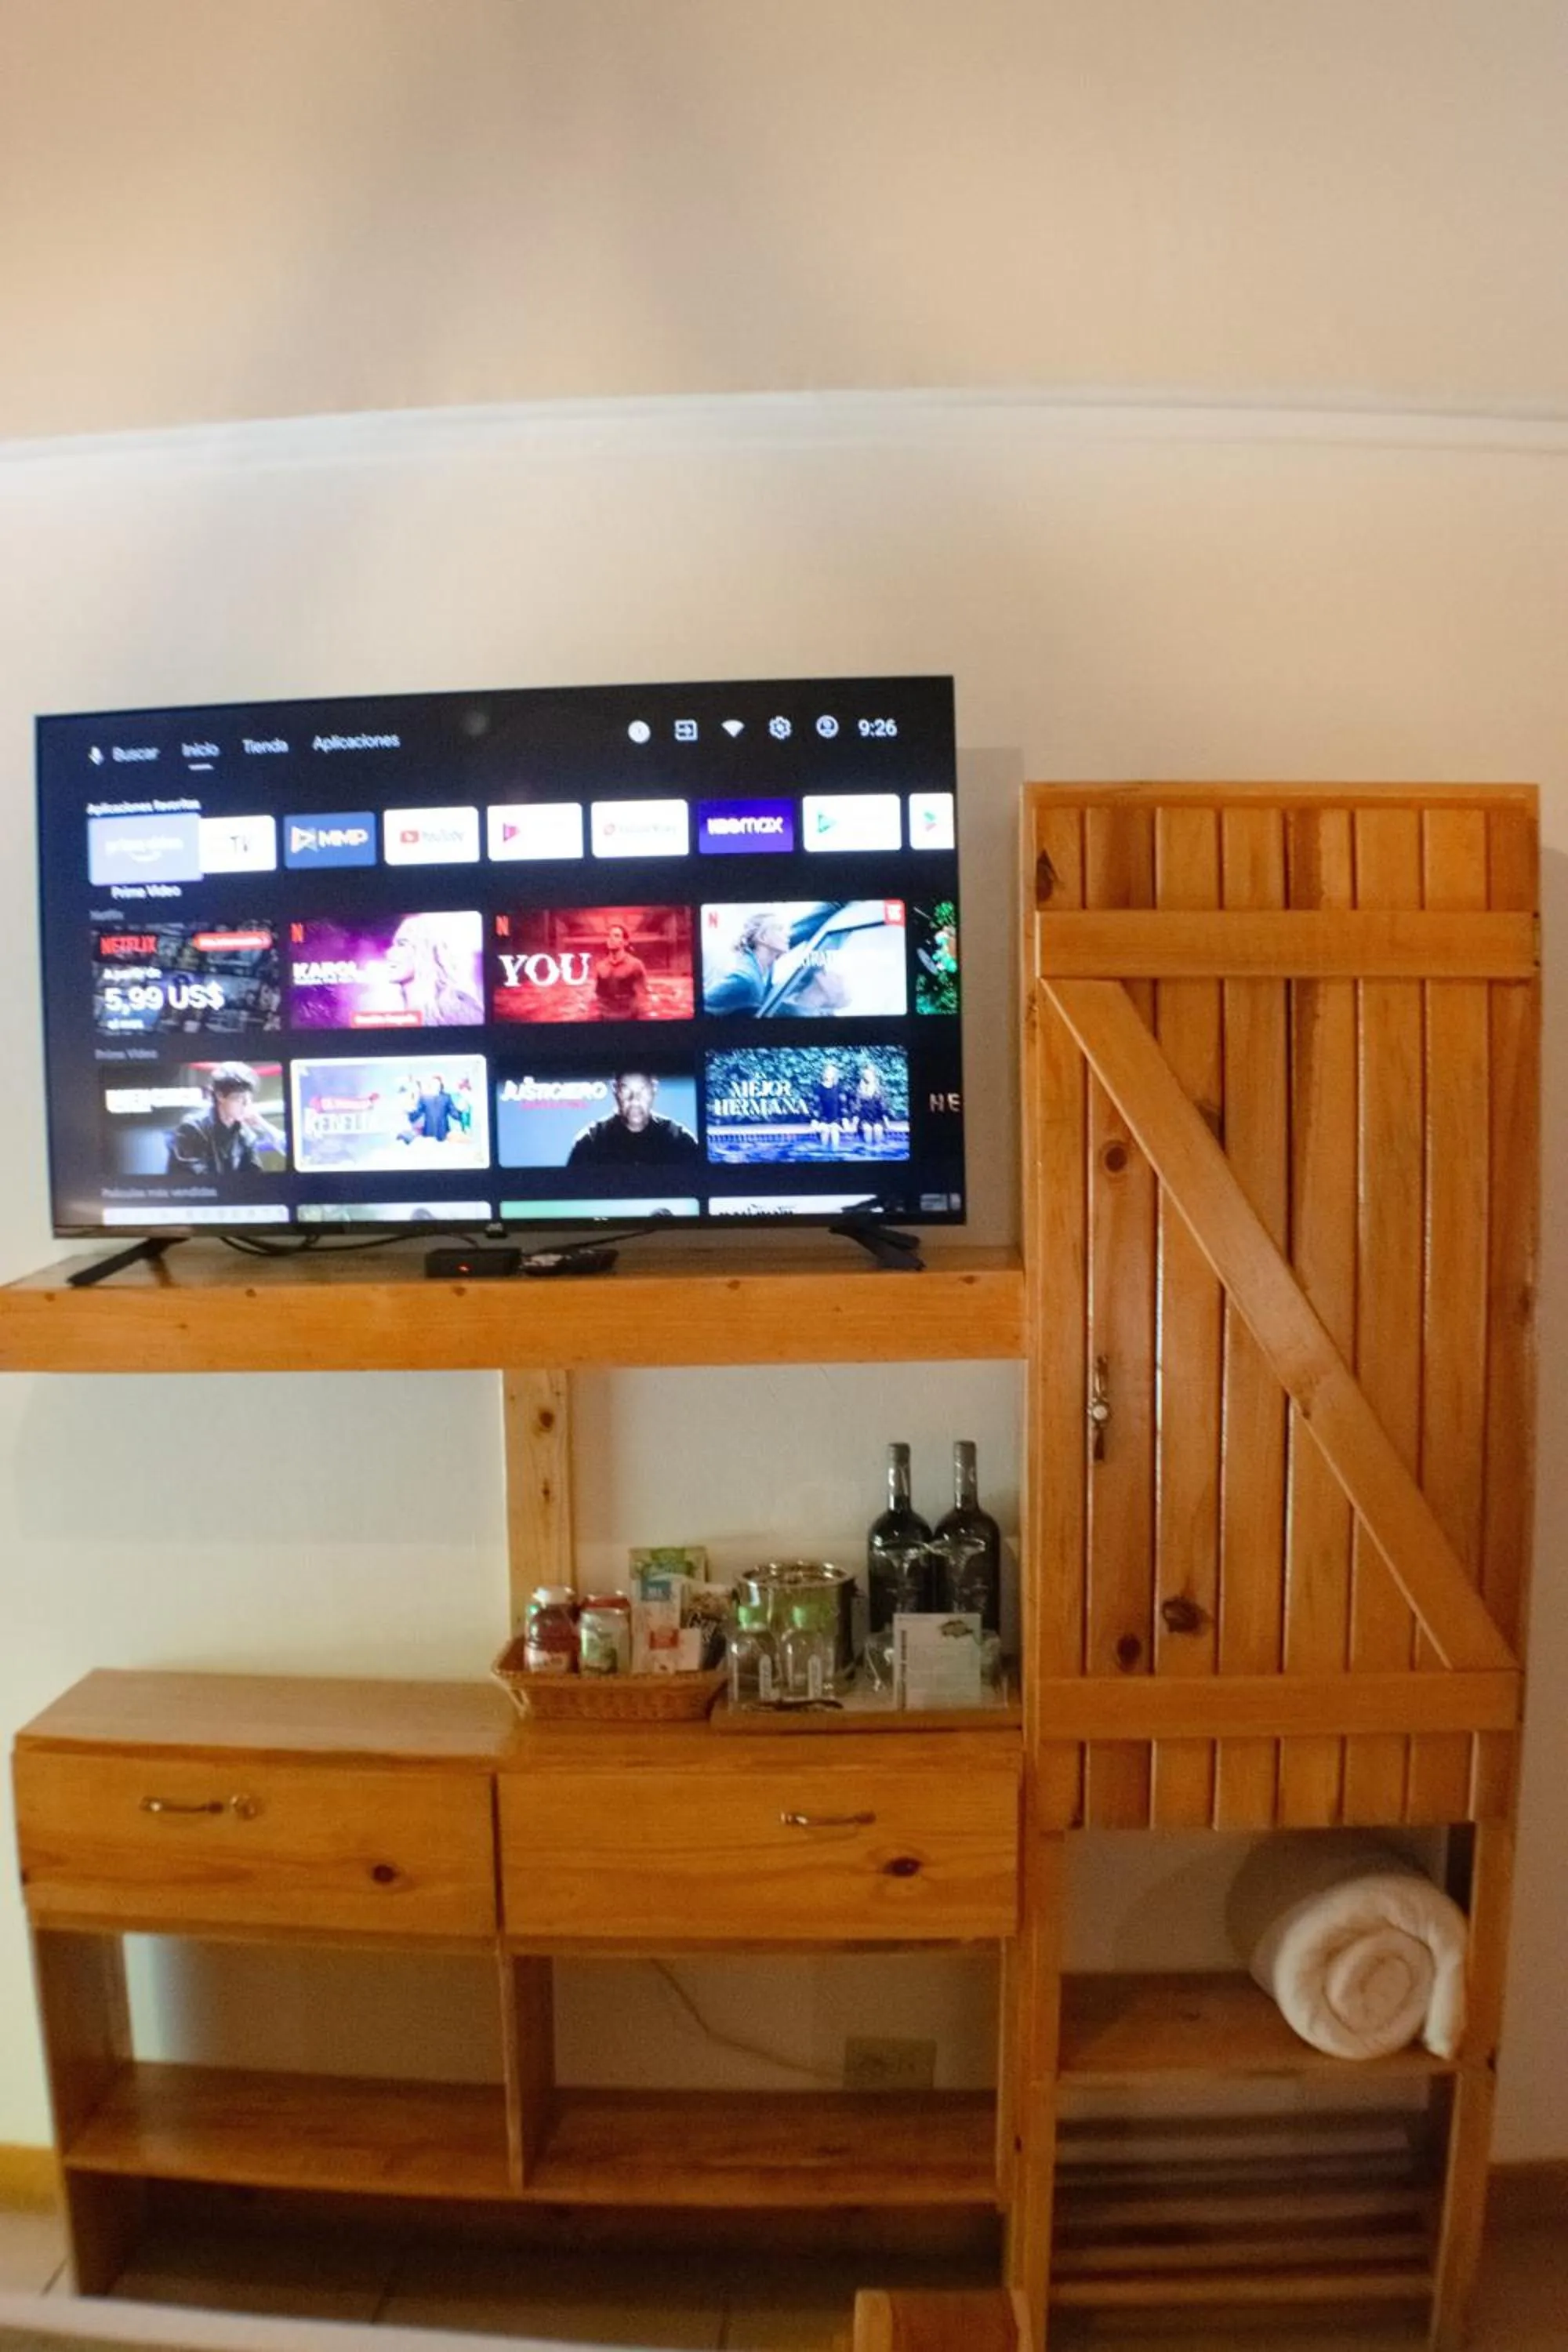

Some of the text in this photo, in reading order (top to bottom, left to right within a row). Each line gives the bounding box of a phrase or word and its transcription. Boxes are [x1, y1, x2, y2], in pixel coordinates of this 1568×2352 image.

[858, 719, 898, 738] 9:26
[182, 742, 220, 758] Inicio
[242, 739, 289, 754] Tienda
[313, 734, 401, 753] Aplicaciones
[112, 746, 159, 763] Buscar
[100, 935, 157, 955] NETFLIX
[499, 951, 591, 988] YOU
[104, 981, 225, 1016] 5,99 US$
[730, 1080, 793, 1098] MEJOR
[713, 1098, 810, 1117] HERMANA
